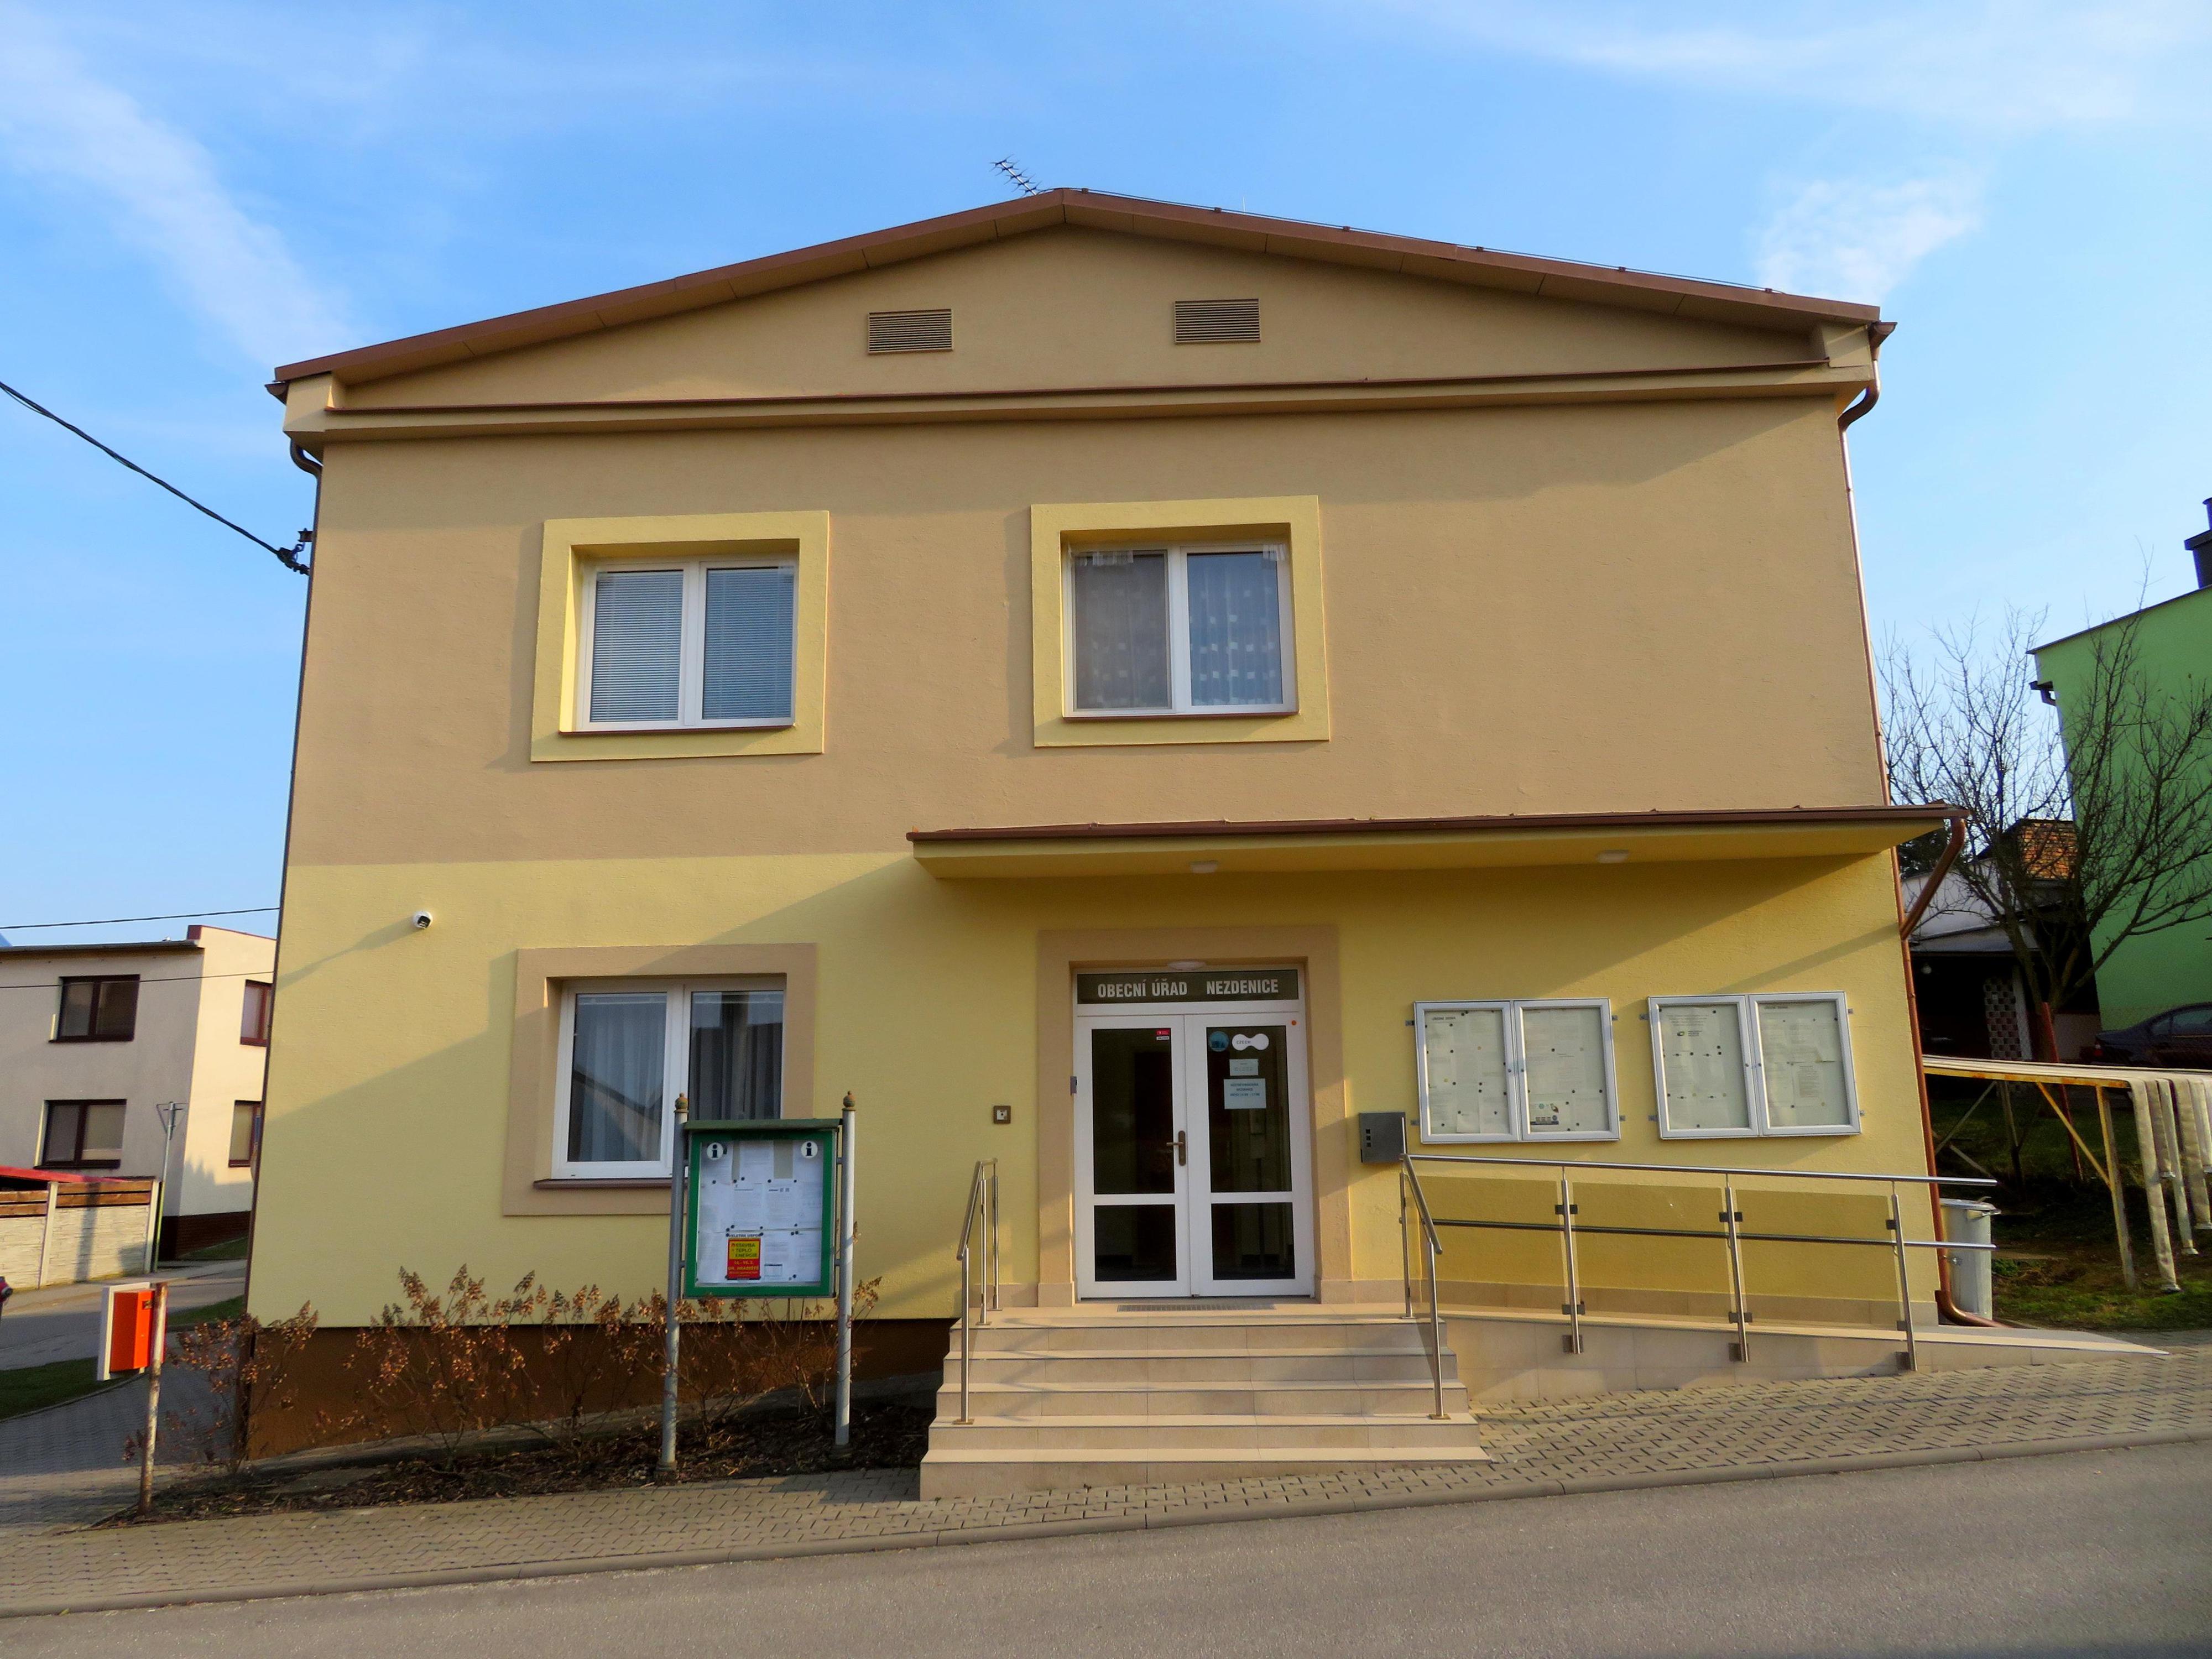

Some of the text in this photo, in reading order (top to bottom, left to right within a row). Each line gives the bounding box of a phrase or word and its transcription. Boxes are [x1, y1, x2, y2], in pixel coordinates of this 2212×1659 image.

[1097, 978, 1279, 998] OBECNÍ ÚŘAD NEZDENICE
